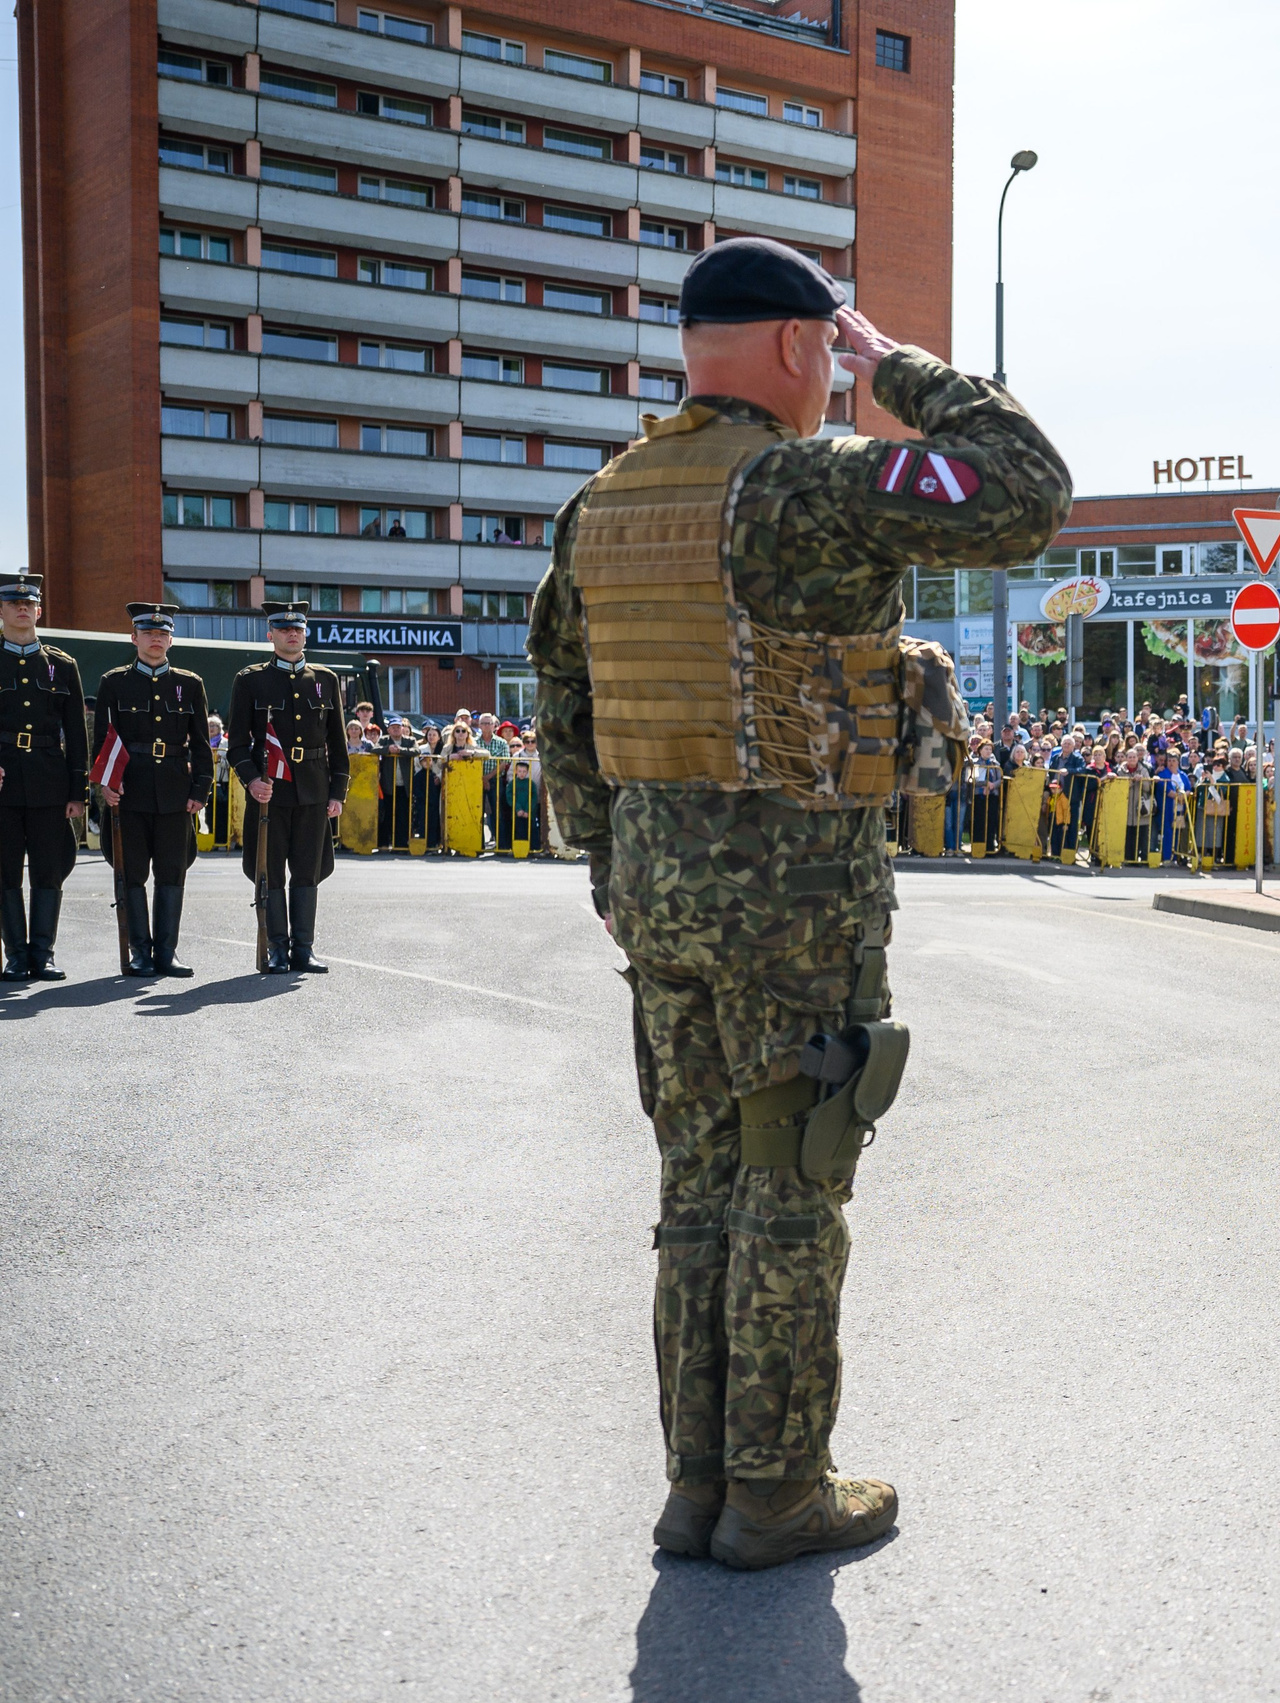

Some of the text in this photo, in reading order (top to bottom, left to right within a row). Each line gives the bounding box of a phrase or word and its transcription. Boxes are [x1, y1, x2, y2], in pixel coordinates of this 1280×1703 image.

[1153, 455, 1253, 485] HOTEL
[1111, 591, 1213, 610] kafejnica
[317, 624, 455, 647] LĀZERKLĪNIKA
[1244, 789, 1252, 856] POLICIJA
